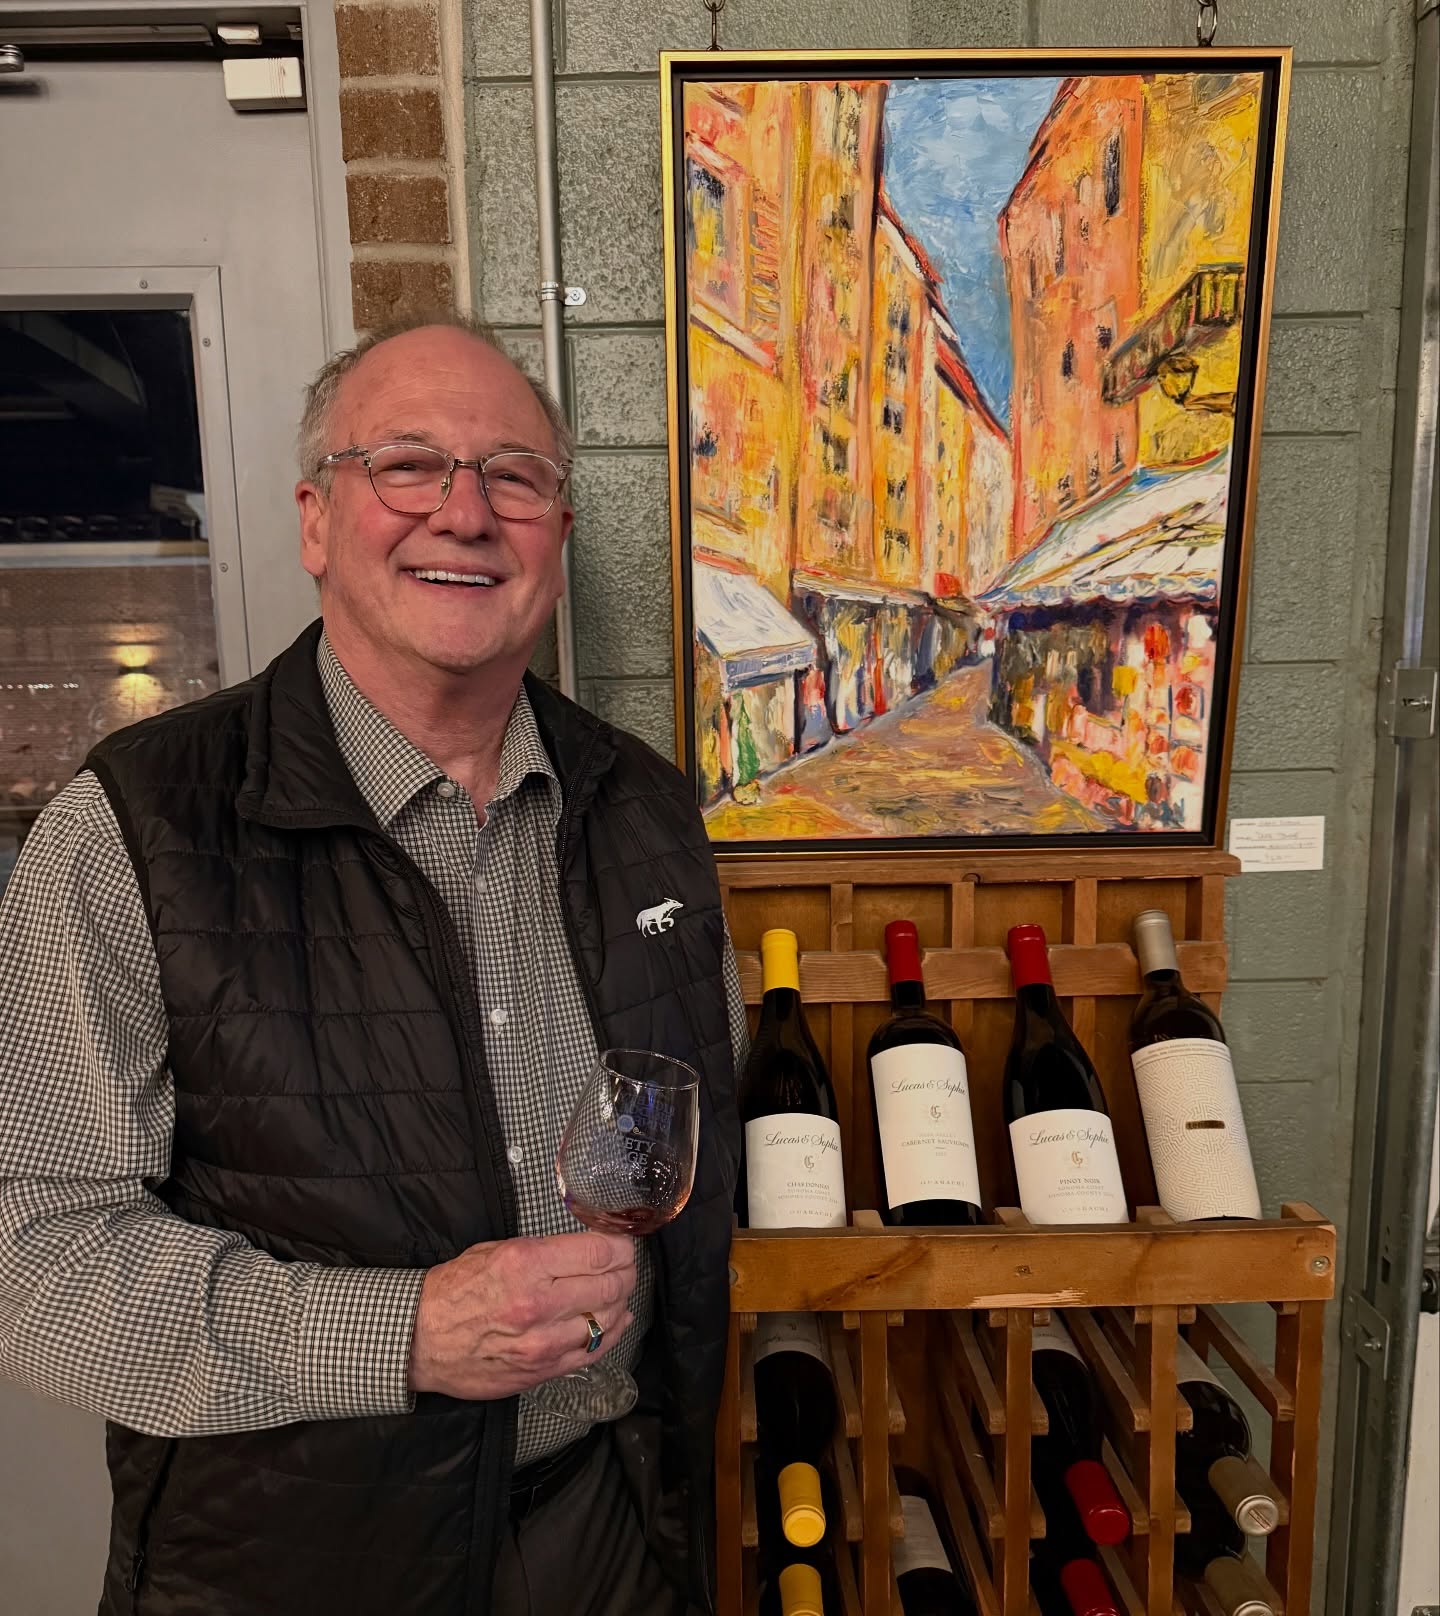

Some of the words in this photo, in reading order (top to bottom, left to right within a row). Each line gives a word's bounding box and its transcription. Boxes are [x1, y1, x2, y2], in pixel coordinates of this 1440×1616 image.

[891, 1080, 925, 1094] Lucas
[926, 1080, 935, 1089] &
[936, 1078, 966, 1097] Sophie
[764, 1131, 800, 1146] Lucas
[801, 1134, 810, 1143] &
[810, 1133, 839, 1154] Sophie
[901, 1138, 935, 1147] CABERNET
[1029, 1129, 1065, 1146] Lucas
[1066, 1130, 1076, 1141] &
[1076, 1128, 1109, 1148] Sophie
[786, 1181, 830, 1190] CHARDONNAY
[1059, 1177, 1081, 1185] PINOT
